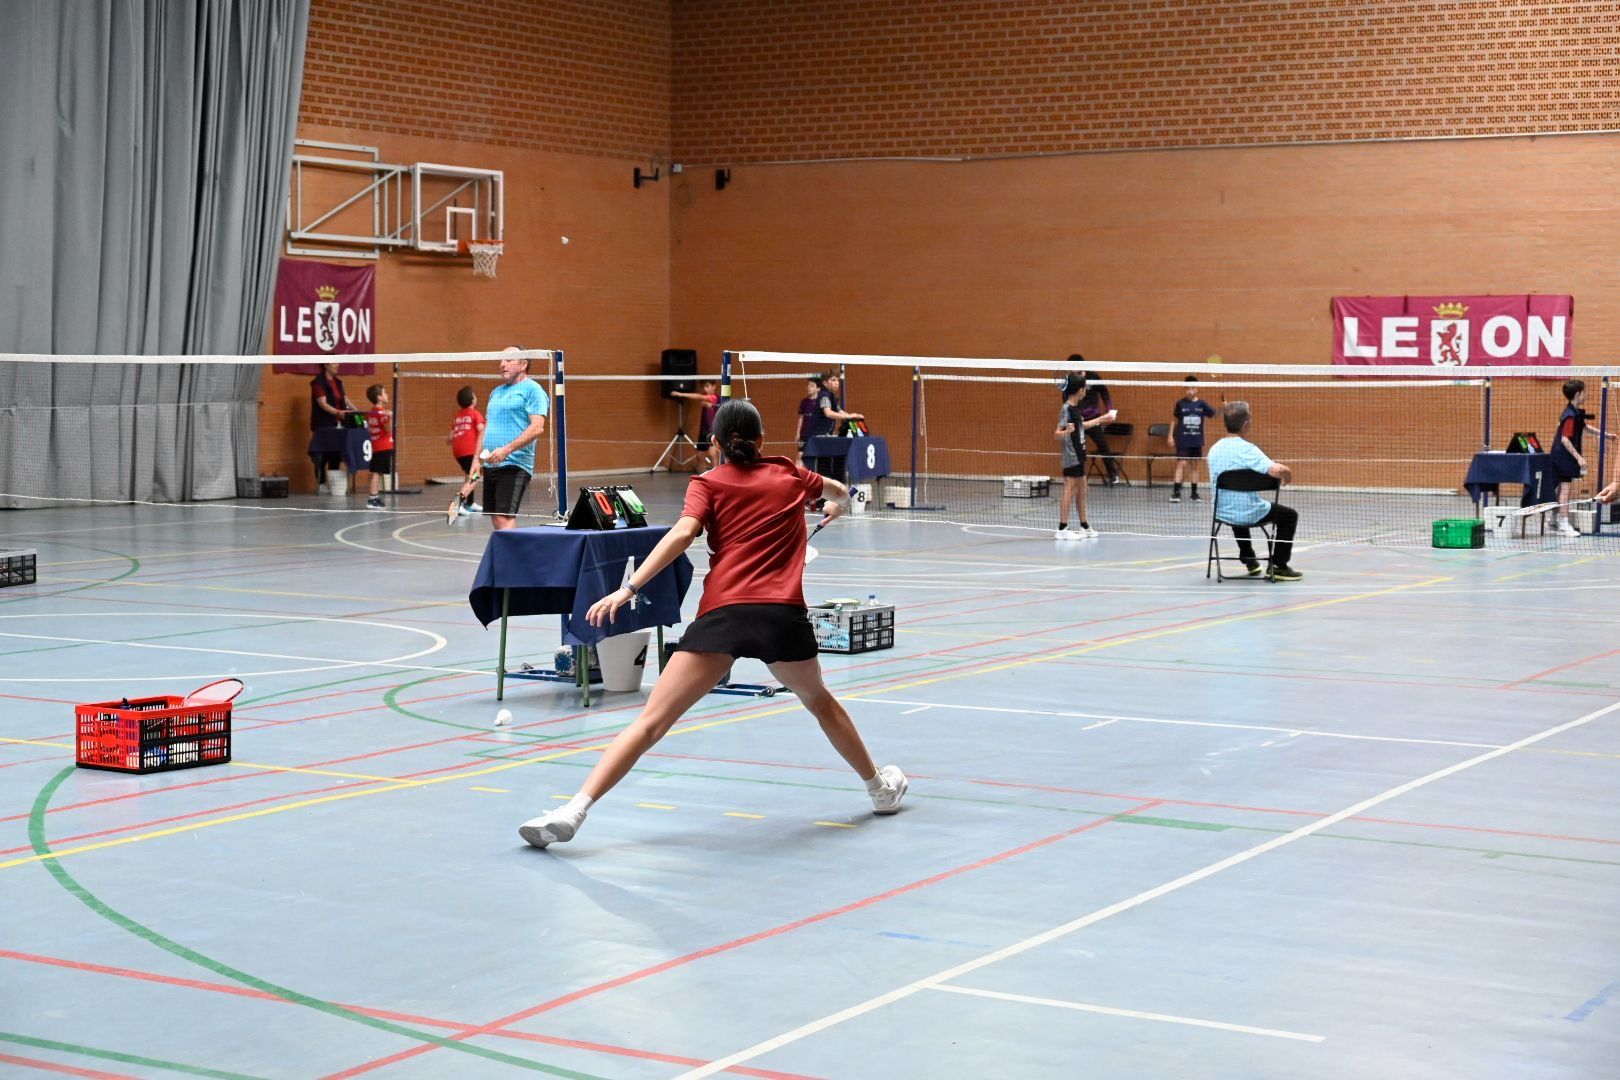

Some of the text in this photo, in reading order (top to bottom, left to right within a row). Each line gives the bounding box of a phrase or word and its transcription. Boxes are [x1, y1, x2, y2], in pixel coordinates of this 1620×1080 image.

[362, 439, 373, 462] 9
[866, 443, 876, 469] 8
[857, 491, 865, 503] 8
[1535, 471, 1543, 500] 7
[1496, 515, 1506, 527] 7
[633, 644, 648, 669] 4
